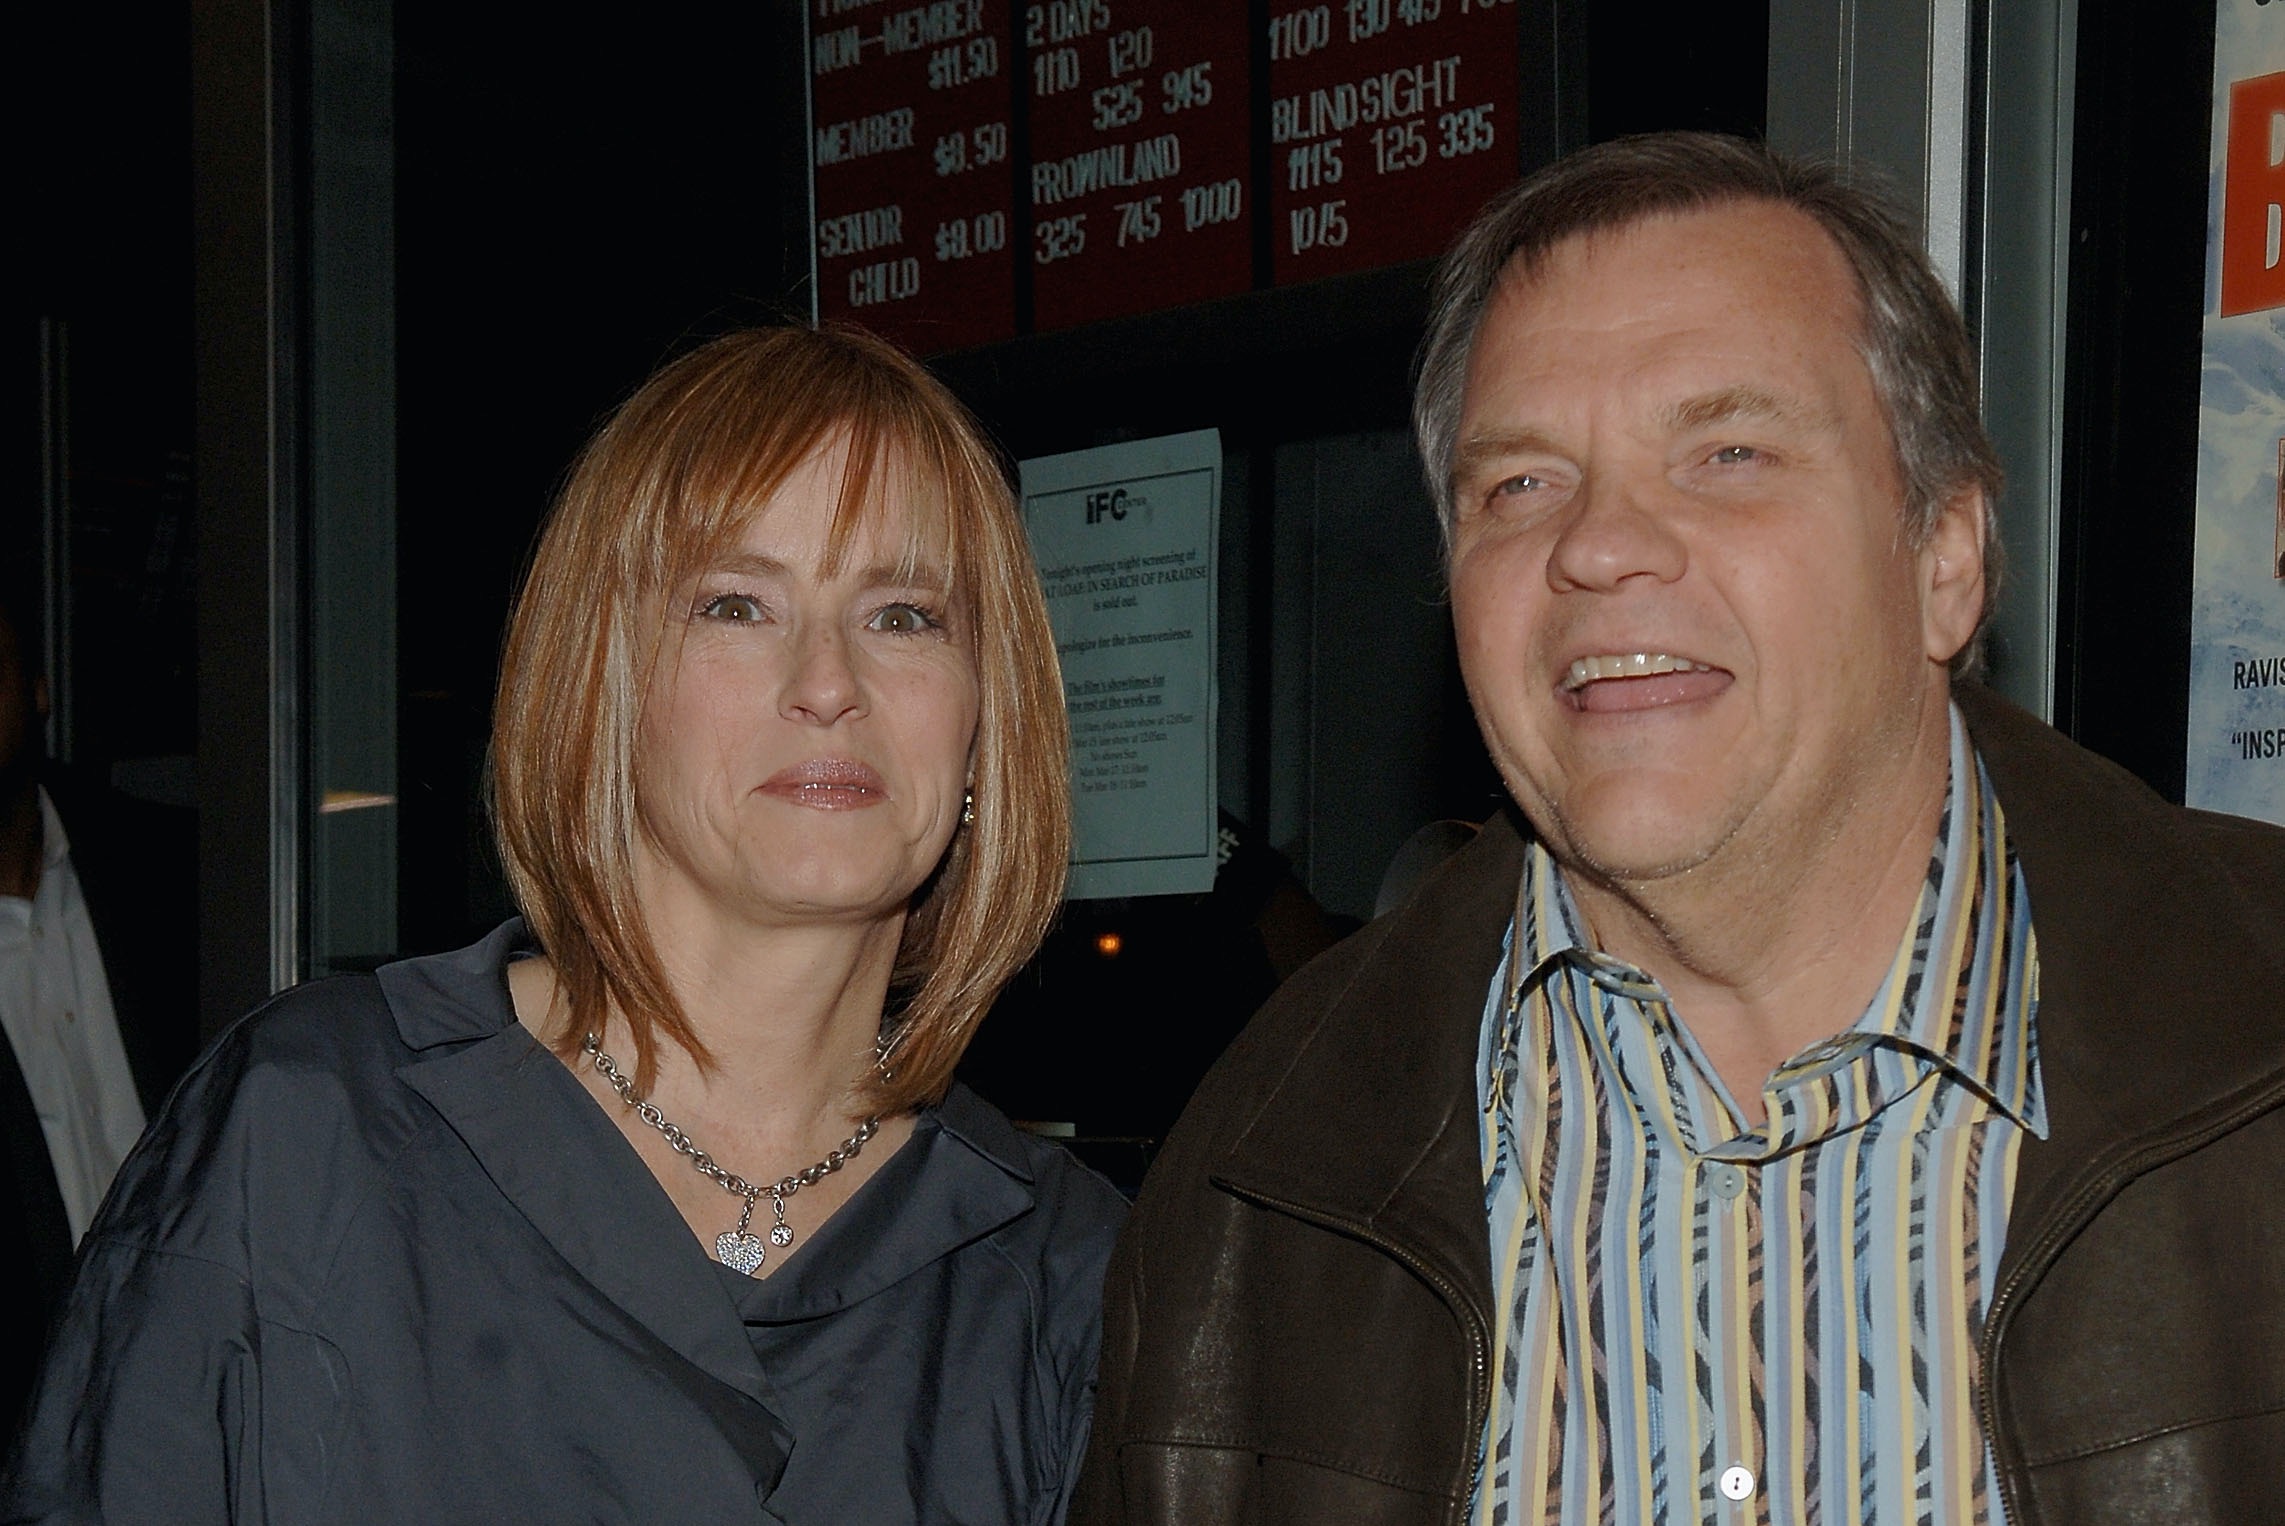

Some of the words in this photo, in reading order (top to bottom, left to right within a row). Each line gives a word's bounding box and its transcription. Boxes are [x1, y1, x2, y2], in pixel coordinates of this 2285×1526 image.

[1026, 4, 1045, 47] 2
[1050, 0, 1110, 43] DAYS
[1109, 26, 1153, 79] 120
[1268, 5, 1330, 60] 1100
[1345, 0, 1390, 43] 130
[928, 36, 998, 90] $11.50
[1091, 78, 1144, 131] 525
[1162, 61, 1212, 114] 945
[1272, 56, 1461, 144] BLINDSIGHT
[816, 107, 914, 166] MEMBER
[1370, 119, 1427, 175] 125
[1439, 103, 1494, 158] 335
[1032, 133, 1181, 205] FROWNLAND
[819, 205, 903, 259] SENIOR
[1035, 213, 1087, 264] 325
[1113, 195, 1162, 248] 745
[1178, 178, 1241, 232] 1000
[849, 257, 920, 307] CHILD
[1099, 573, 1139, 591] SEARCH
[1140, 570, 1156, 586] OF
[1157, 565, 1208, 585] PARADISE
